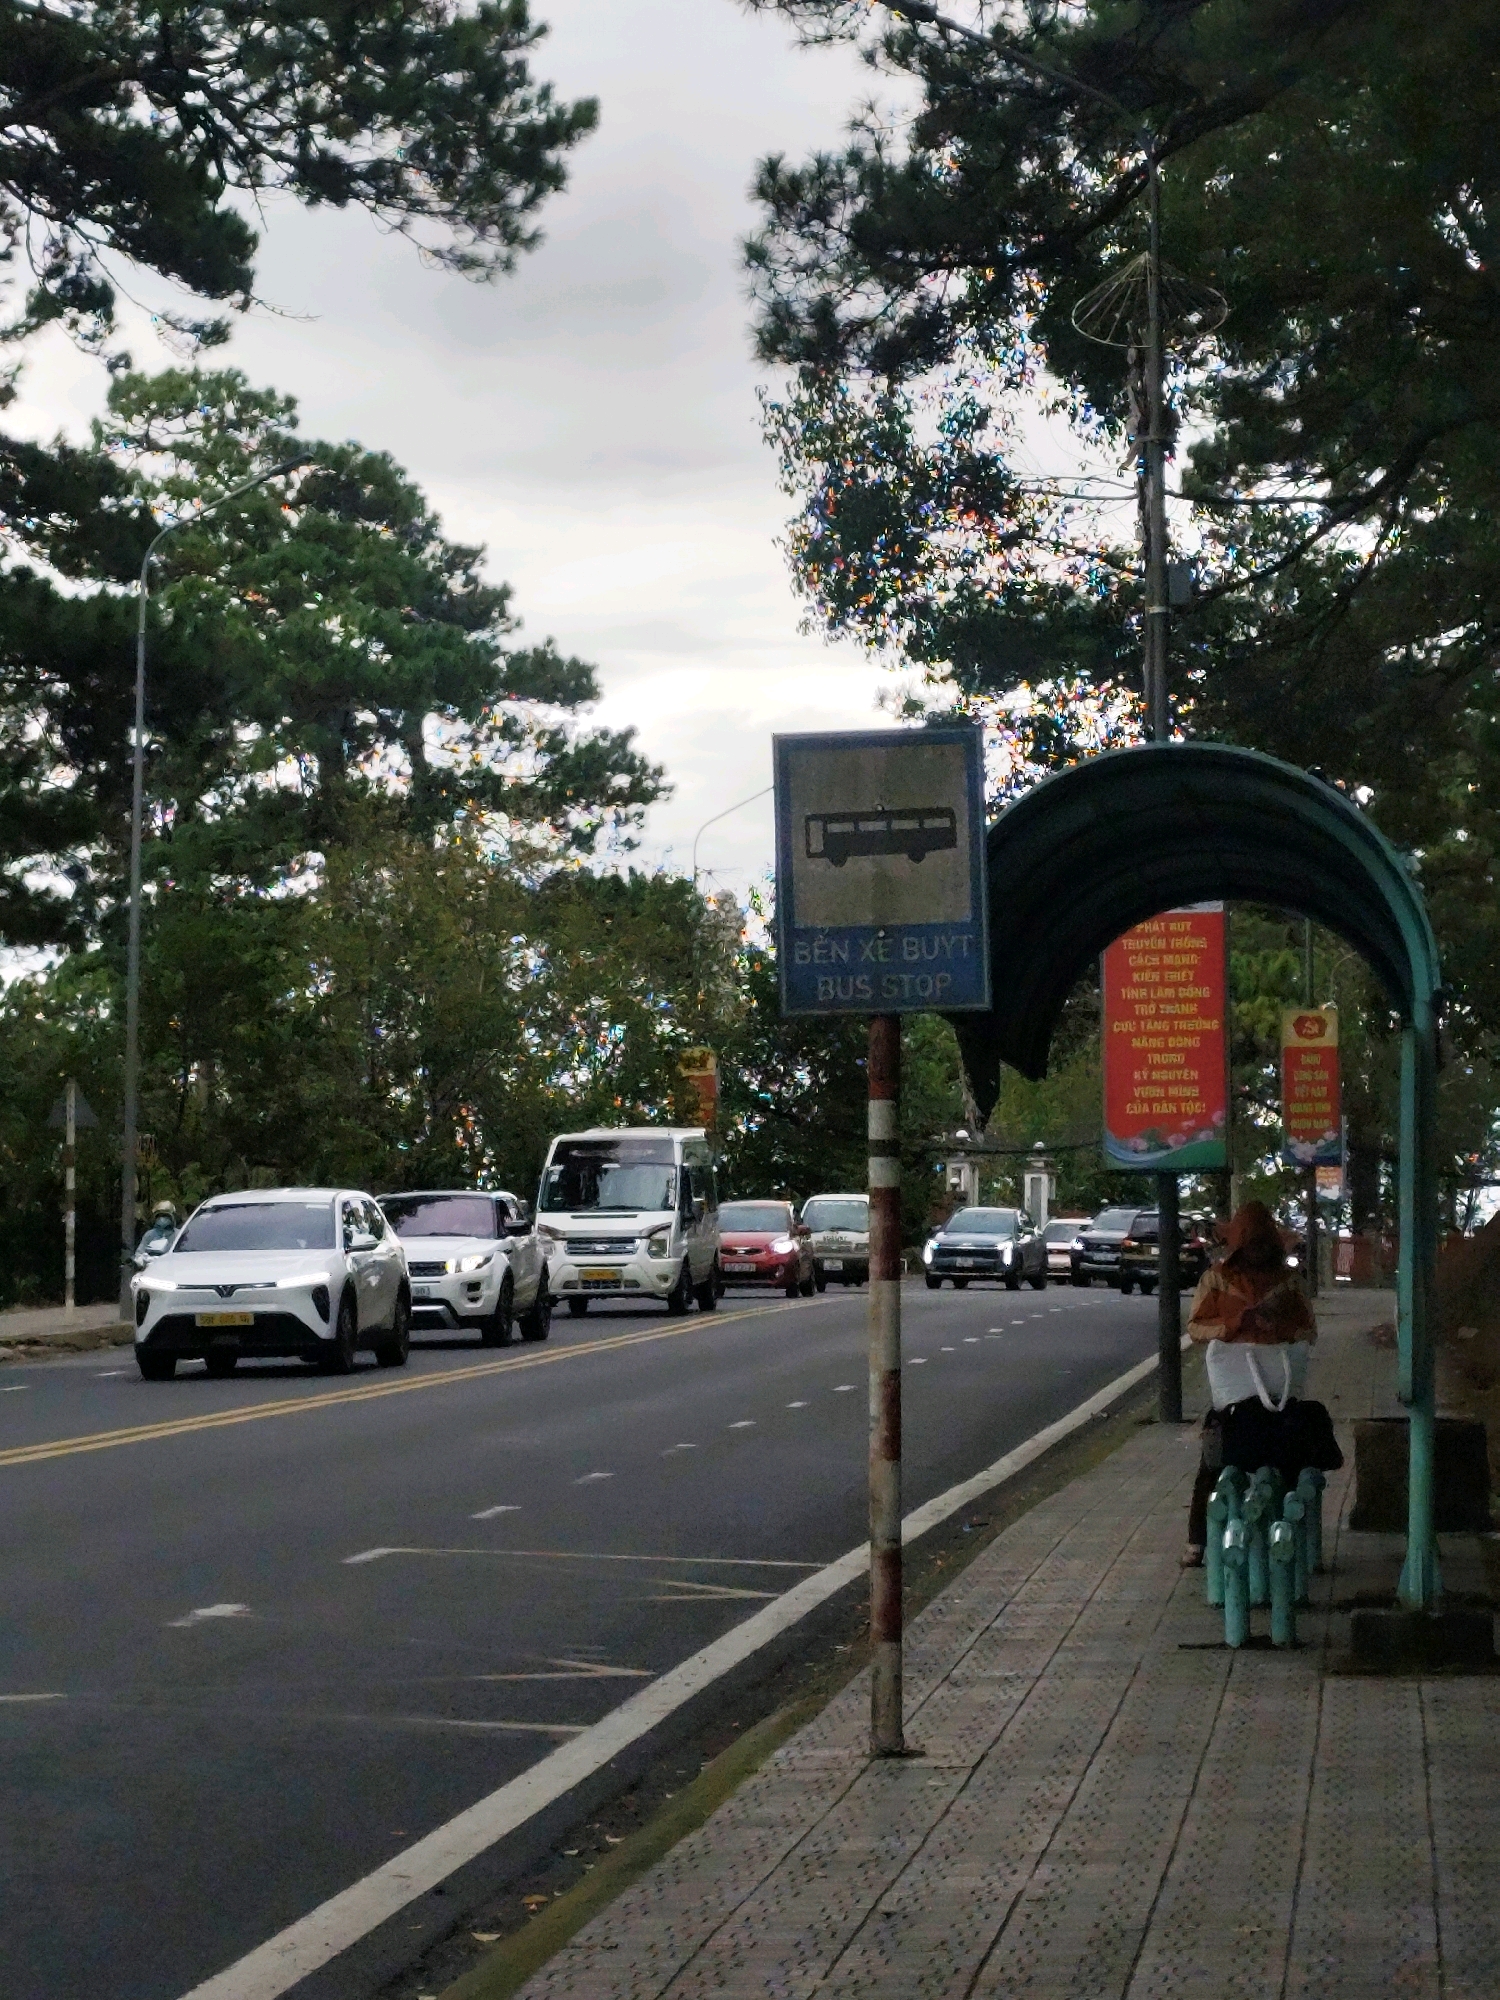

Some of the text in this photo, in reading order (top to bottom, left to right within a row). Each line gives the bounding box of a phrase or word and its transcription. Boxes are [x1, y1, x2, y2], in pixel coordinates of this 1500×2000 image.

[860, 936, 894, 963] XE
[817, 973, 952, 1001] BUS STOP
